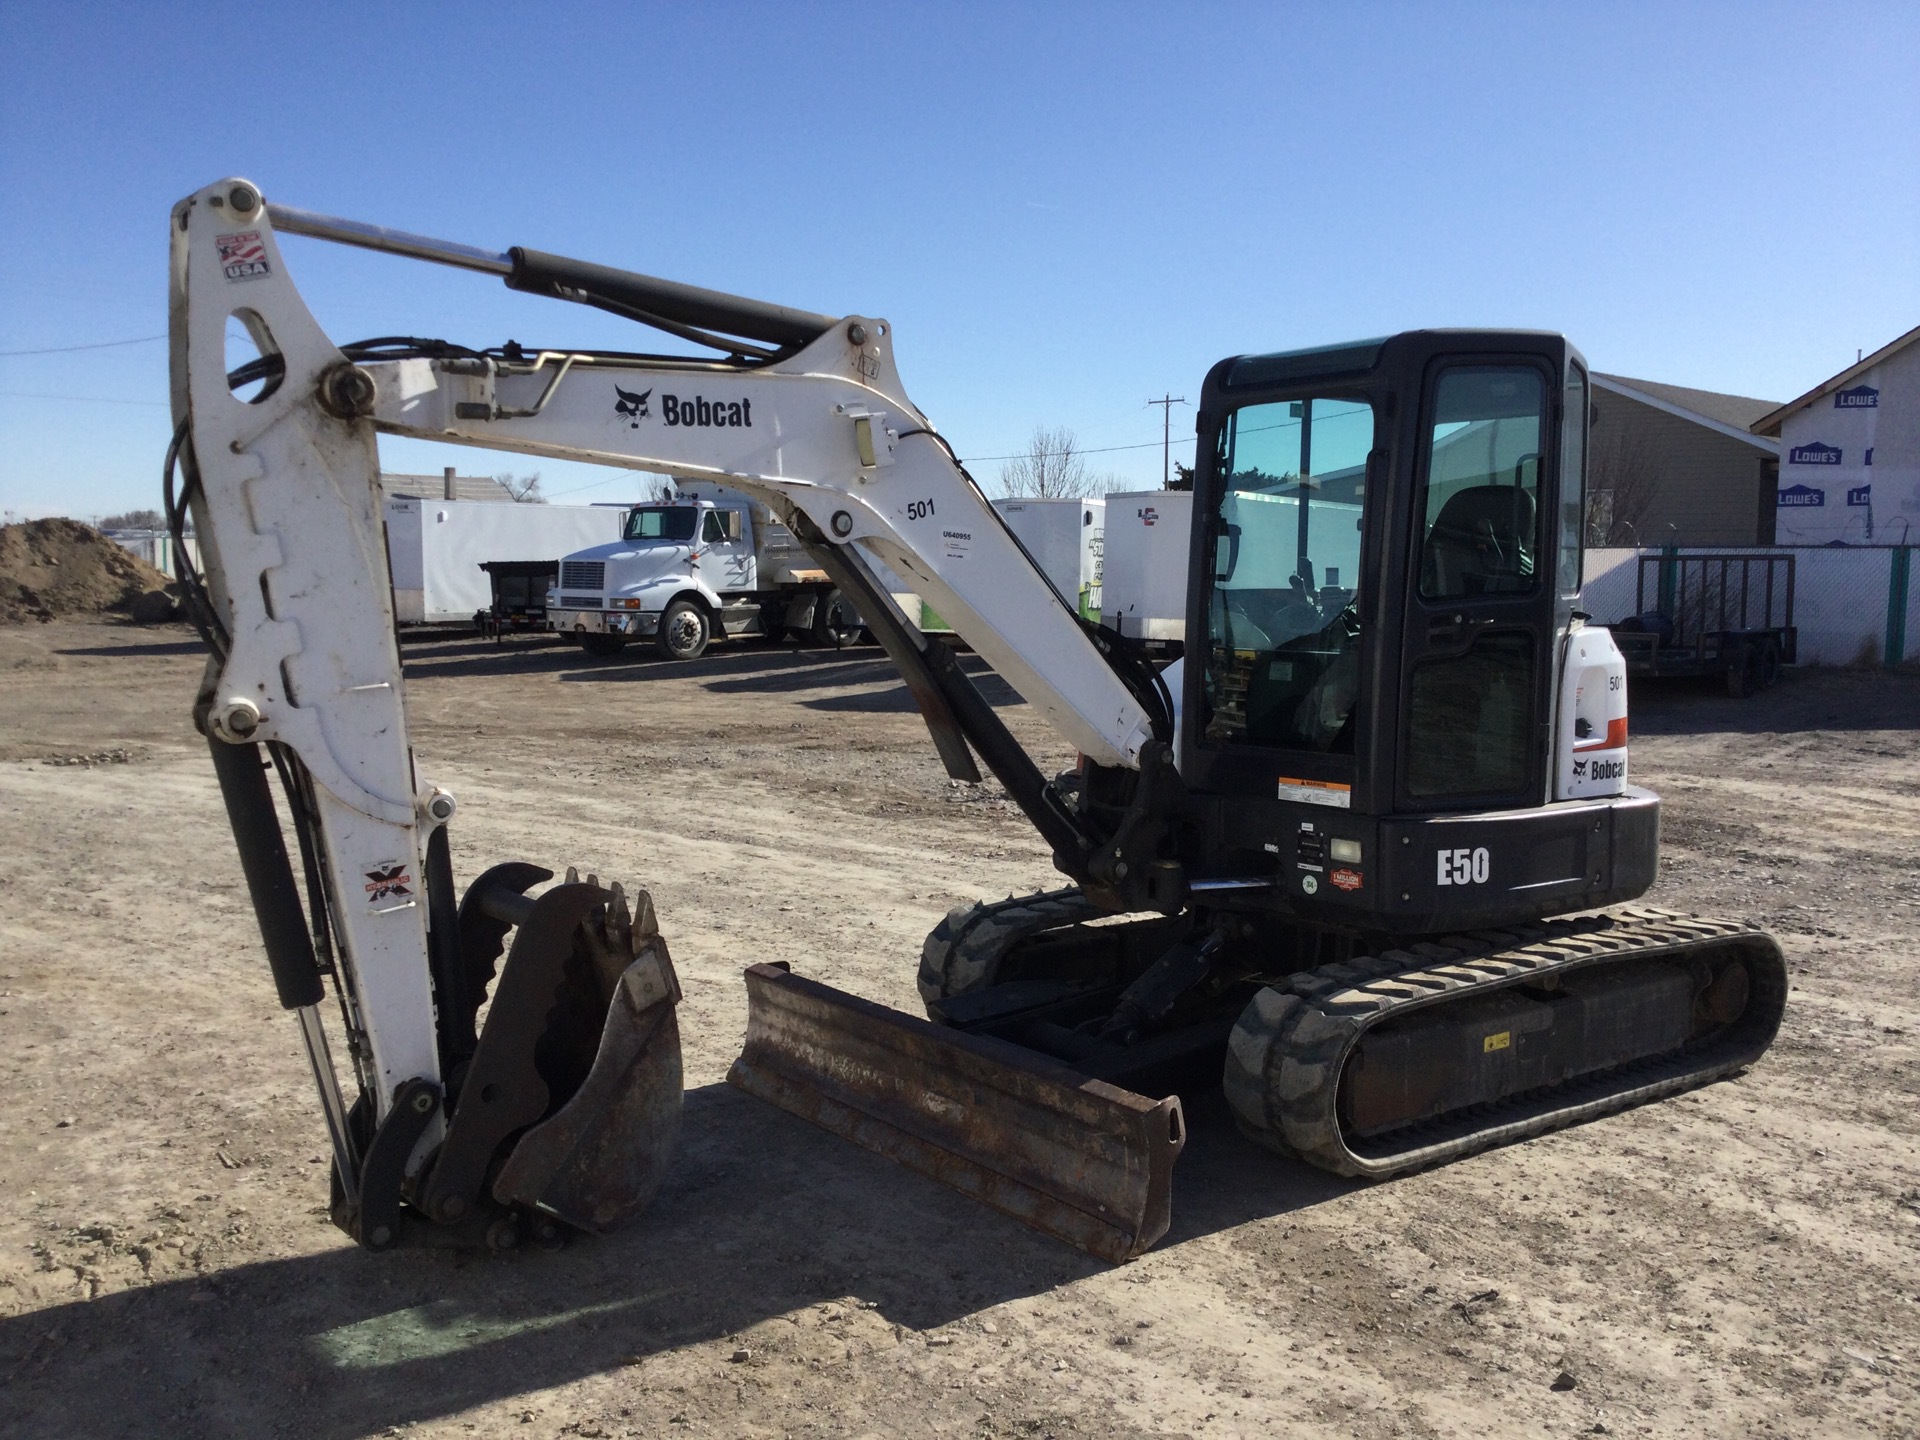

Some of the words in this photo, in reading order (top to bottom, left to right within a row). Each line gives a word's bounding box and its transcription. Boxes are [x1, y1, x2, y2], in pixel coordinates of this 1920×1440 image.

[226, 262, 267, 278] USA
[662, 394, 752, 427] Bobcat
[1795, 449, 1837, 462] LOWE'S
[1778, 492, 1820, 505] LOWE'S
[907, 498, 935, 521] 501
[1609, 675, 1623, 692] 501
[1591, 759, 1625, 781] Bobcat
[1437, 847, 1490, 886] E50
